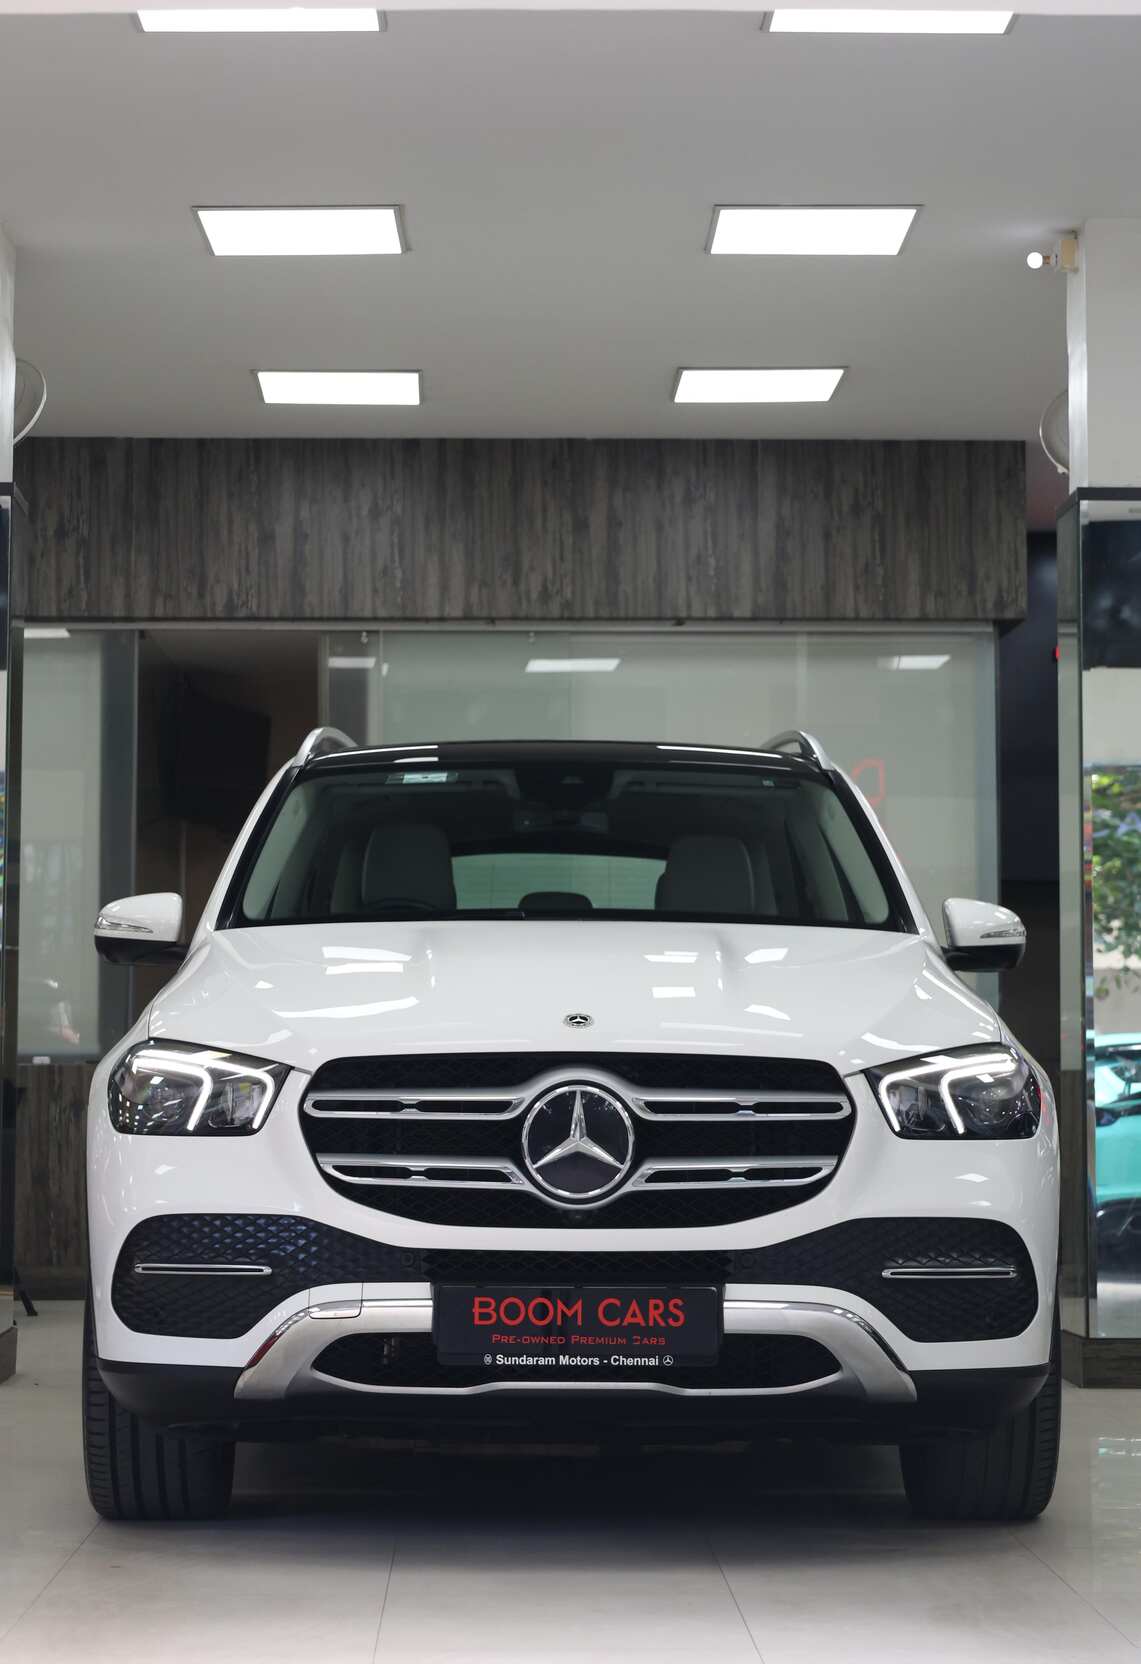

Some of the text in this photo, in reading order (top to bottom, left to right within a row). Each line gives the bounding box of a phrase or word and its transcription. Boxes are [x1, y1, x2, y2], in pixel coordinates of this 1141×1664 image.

[472, 1296, 686, 1327] BOOM CARS
[571, 1335, 627, 1345] PREMIUM
[495, 1354, 556, 1365] Sundaram
[559, 1354, 600, 1366] Motors
[610, 1355, 659, 1366] Chennai
